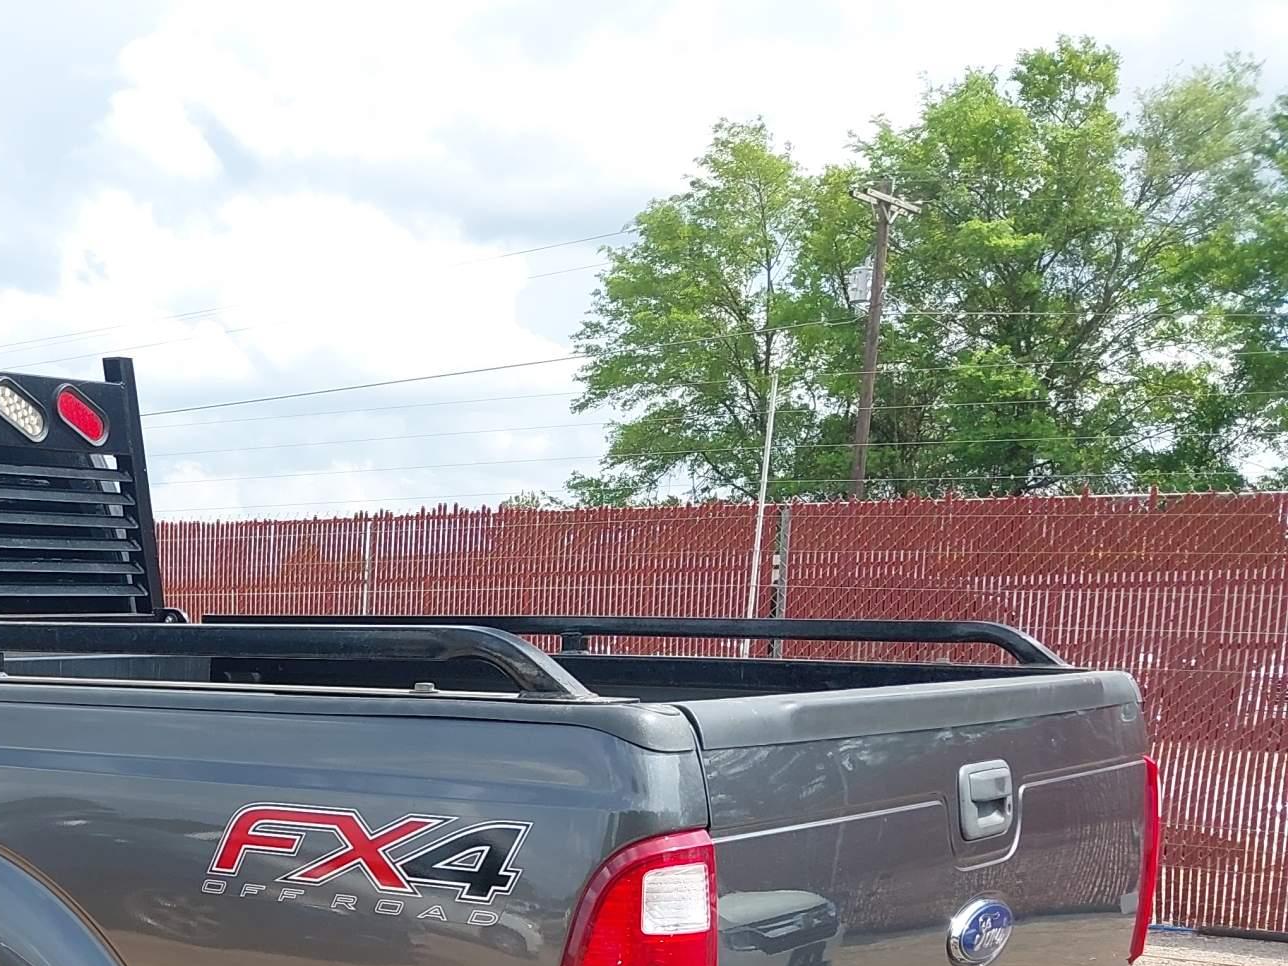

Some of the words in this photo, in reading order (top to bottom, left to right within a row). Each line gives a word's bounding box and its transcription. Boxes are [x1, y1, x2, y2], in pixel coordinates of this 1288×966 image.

[207, 802, 533, 904] FX4
[201, 879, 305, 902] OFF
[330, 893, 500, 926] ROAD
[966, 911, 1008, 952] Ford
